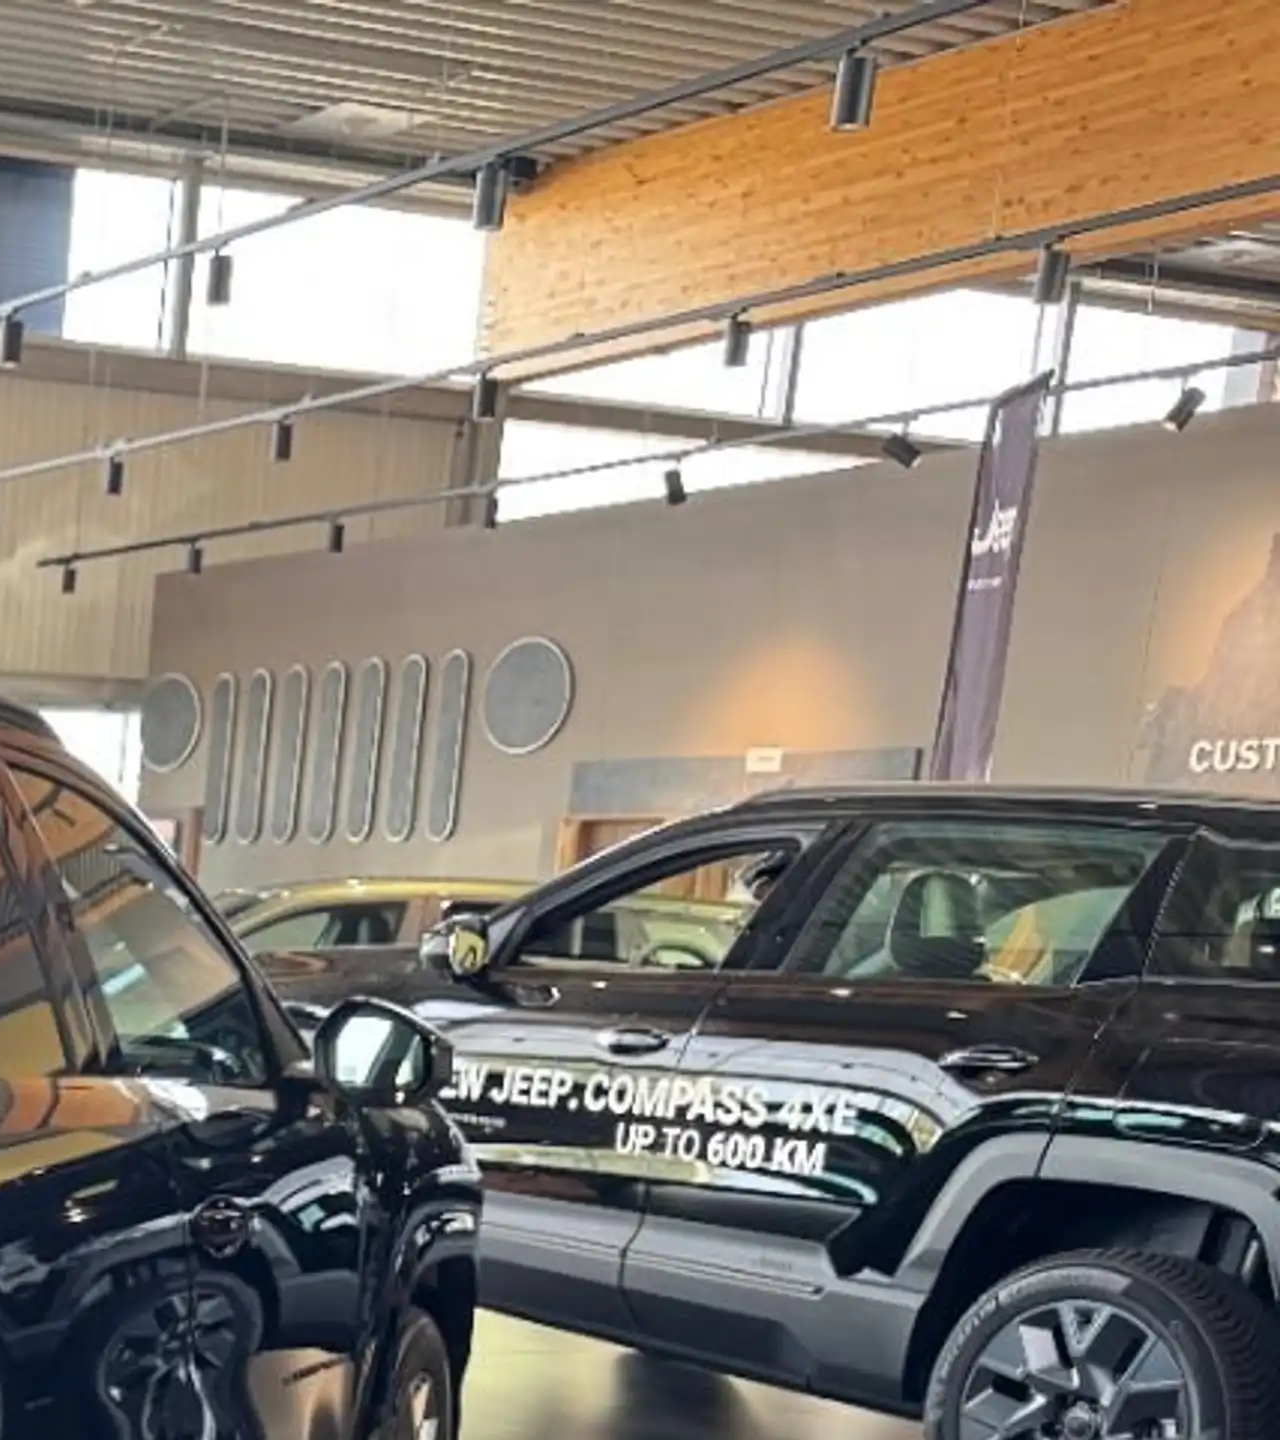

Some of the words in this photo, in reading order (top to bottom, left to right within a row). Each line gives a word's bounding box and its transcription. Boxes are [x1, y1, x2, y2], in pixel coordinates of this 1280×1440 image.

[584, 1073, 768, 1128] COMPASS
[777, 1087, 858, 1135] 4XE
[615, 1121, 656, 1157] UP
[662, 1127, 700, 1161] TO
[707, 1130, 764, 1168] 600
[771, 1137, 828, 1176] KM
